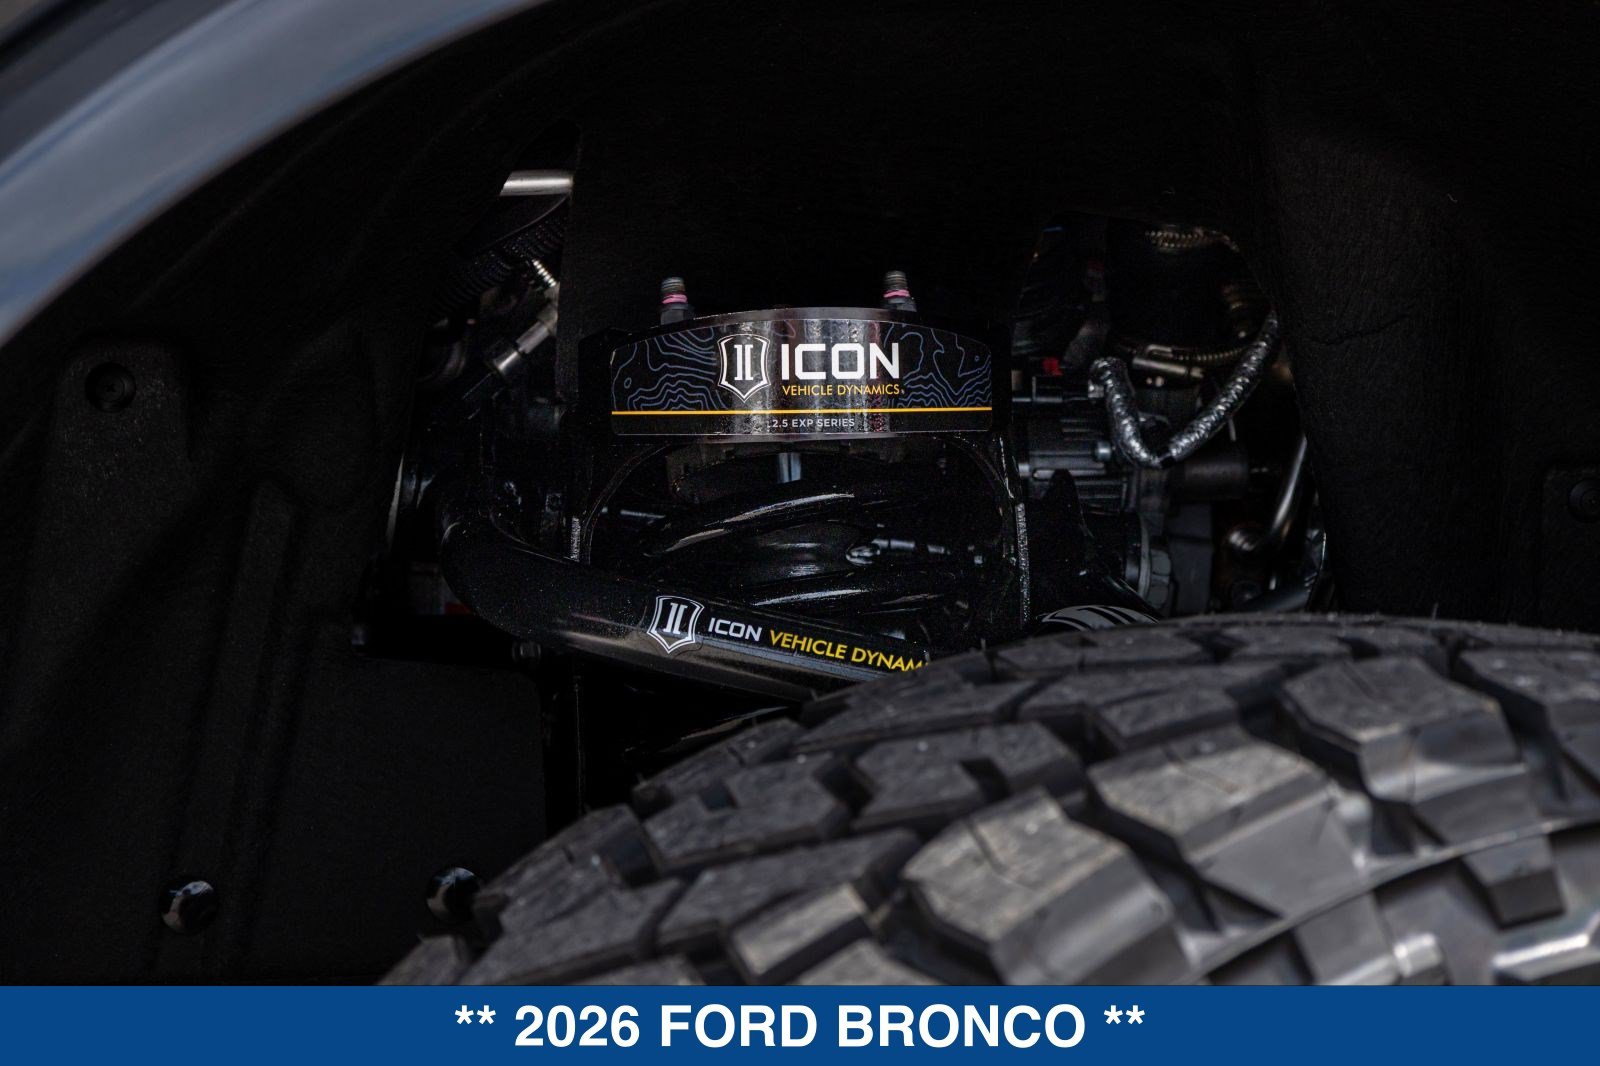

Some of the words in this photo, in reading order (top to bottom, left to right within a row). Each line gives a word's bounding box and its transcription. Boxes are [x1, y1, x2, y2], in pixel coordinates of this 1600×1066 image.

[781, 342, 900, 381] ICON
[782, 384, 833, 396] VEHICLE
[837, 383, 900, 395] DYNAMICS
[772, 419, 788, 428] 2.5
[791, 419, 814, 428] EXP
[817, 418, 855, 427] SERIES
[708, 617, 762, 642] ICON
[769, 629, 848, 660] VEHICLE
[851, 647, 929, 672] DYNAM
